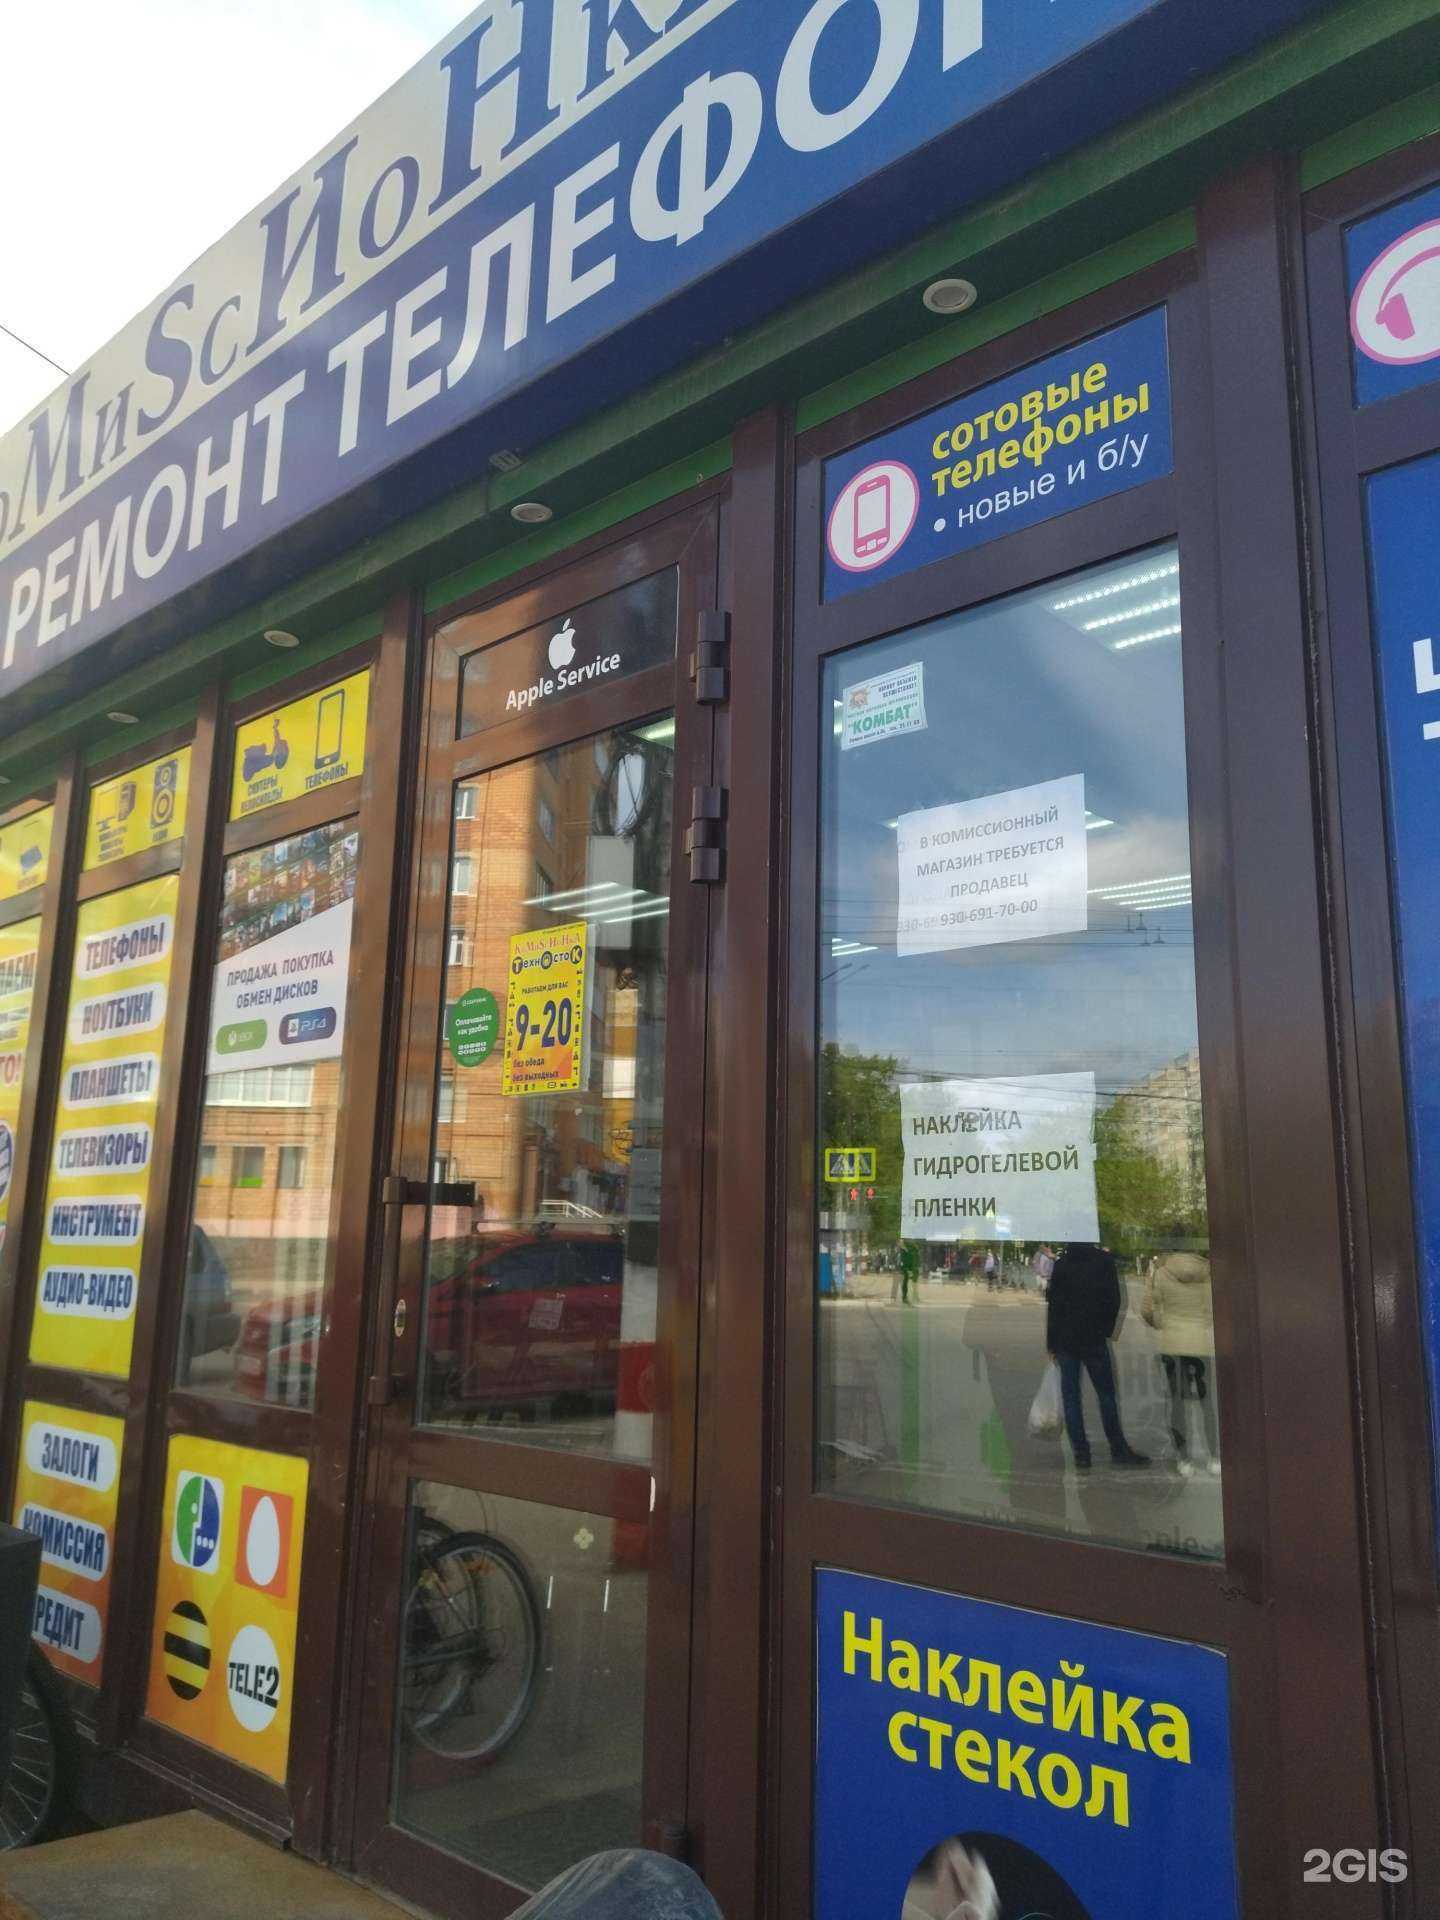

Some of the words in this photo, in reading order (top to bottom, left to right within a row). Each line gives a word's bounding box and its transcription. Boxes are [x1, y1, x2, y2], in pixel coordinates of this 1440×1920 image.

[2, 369, 306, 669] РЕМОНТ
[327, 0, 982, 458] ТЕЛЕФО
[932, 362, 1107, 460] сотовые
[931, 383, 1149, 496] телефоны
[958, 473, 1055, 528] новые
[1067, 459, 1086, 485] и
[1098, 433, 1149, 472] б/у
[505, 677, 554, 711] Apple
[557, 653, 621, 691] Service
[919, 836, 928, 849] В
[932, 804, 1059, 847] КОМИССИОННЫЙ
[916, 853, 983, 877] МАГАЗИН
[986, 836, 1064, 863] ТРЕБУЕТСЯ
[950, 872, 1029, 898] ПРОДАВЕЦ
[939, 899, 1038, 927] 930-691-70-00
[86, 922, 165, 972] ТЕЛЕФОНЫ
[227, 962, 278, 987] ПРОДАЖА
[282, 949, 334, 975] ПОКУПКА
[82, 990, 154, 1035] НОУТБУКИ
[236, 987, 272, 1009] ОБМЕН
[273, 979, 319, 1005] ДИСКОВ
[516, 998, 572, 1051] 9-20
[69, 1060, 152, 1102] ПЛАНШЕТЫ
[913, 1108, 1022, 1136] НАКЛЕЙКА
[59, 1131, 149, 1169] ТЕЛЕВИЗОРЫ
[913, 1144, 1079, 1179] ГИДРОГЕЛЕВОЙ
[51, 1203, 141, 1237] ИНСТРУМЕНТ
[914, 1197, 997, 1217] ПЛЕНКИ
[43, 1271, 133, 1312] АУДИО-ВИДЕО
[42, 1433, 100, 1483] ЗАЛОГИ
[34, 1595, 84, 1650] РЕДИТ
[228, 1661, 279, 1709] TELE2
[843, 1610, 1191, 1764] Наклейка
[888, 1710, 1130, 1828] стекол
